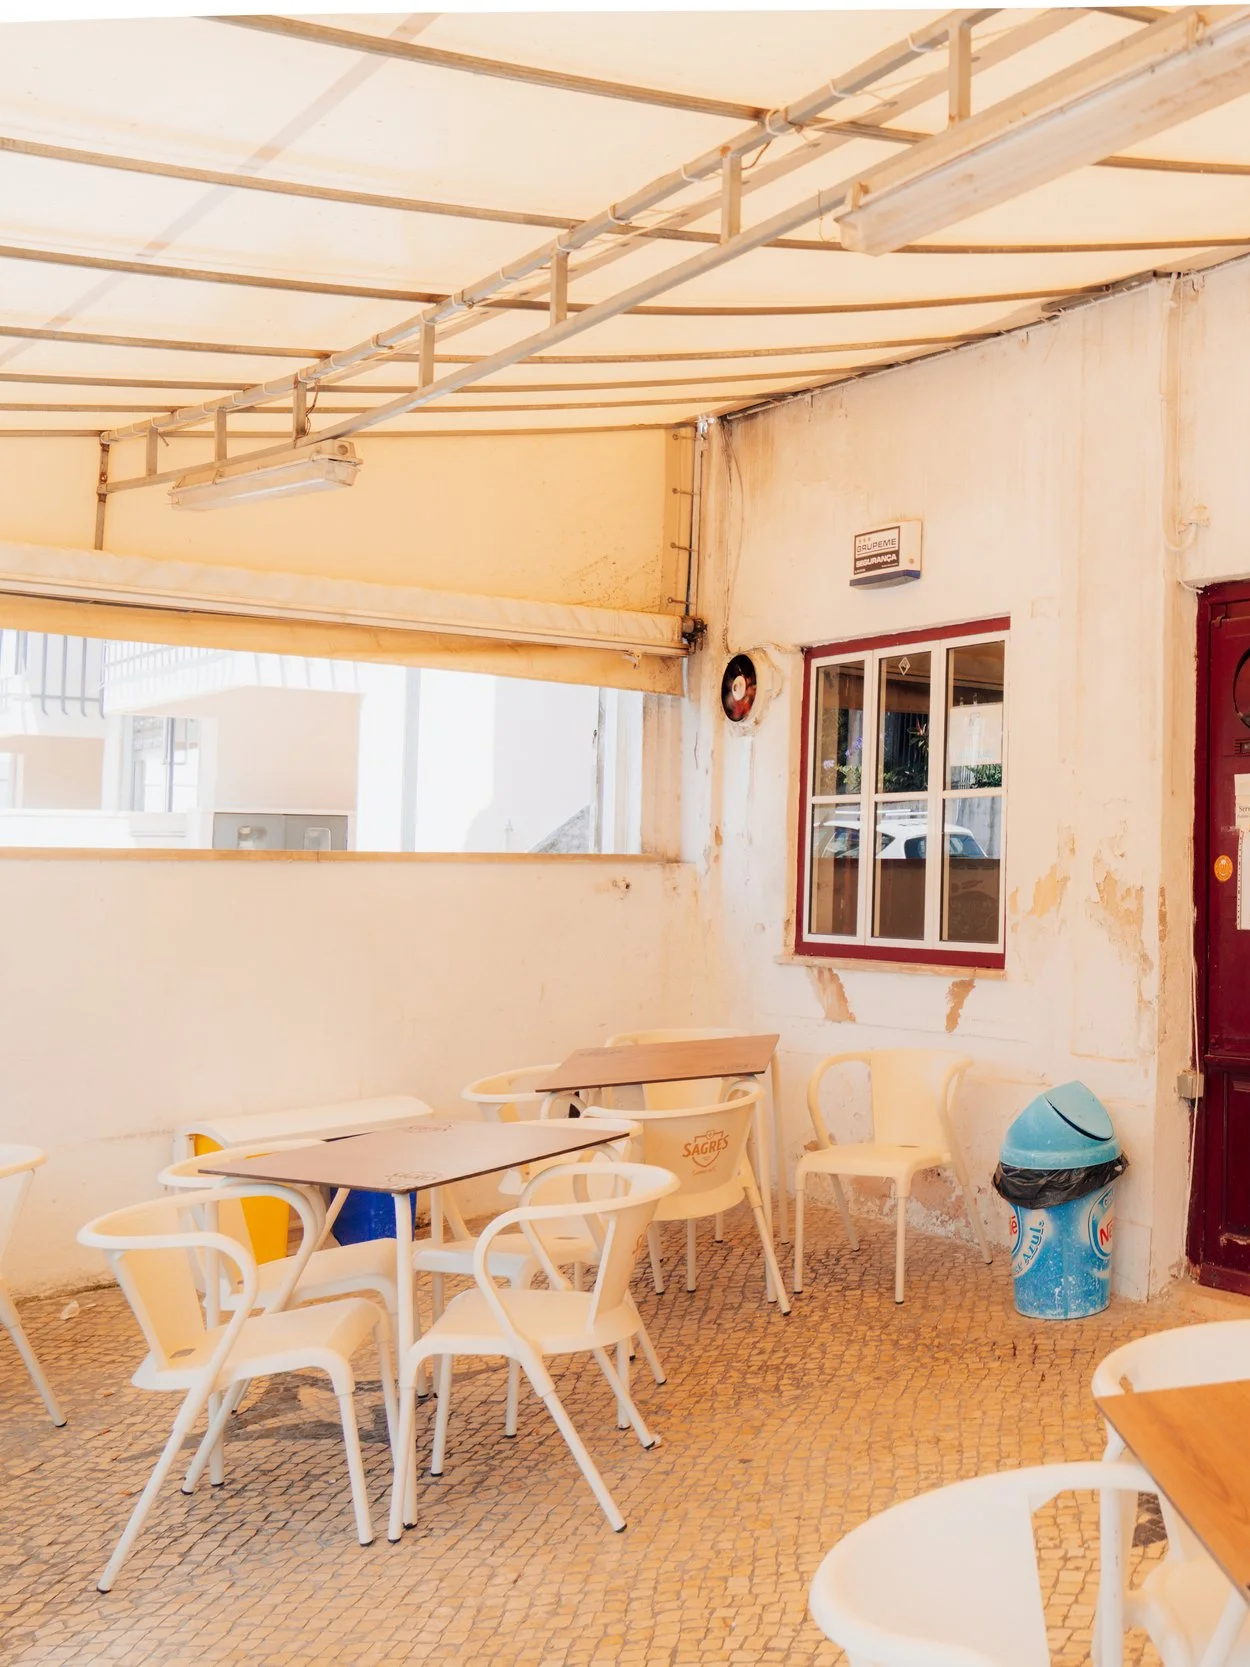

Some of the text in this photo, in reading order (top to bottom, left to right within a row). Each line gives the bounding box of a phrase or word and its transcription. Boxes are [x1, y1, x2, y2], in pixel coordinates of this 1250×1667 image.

[856, 538, 897, 553] GRUPEME
[856, 553, 898, 568] SEGURANÇA
[682, 1134, 730, 1157] SAGRES
